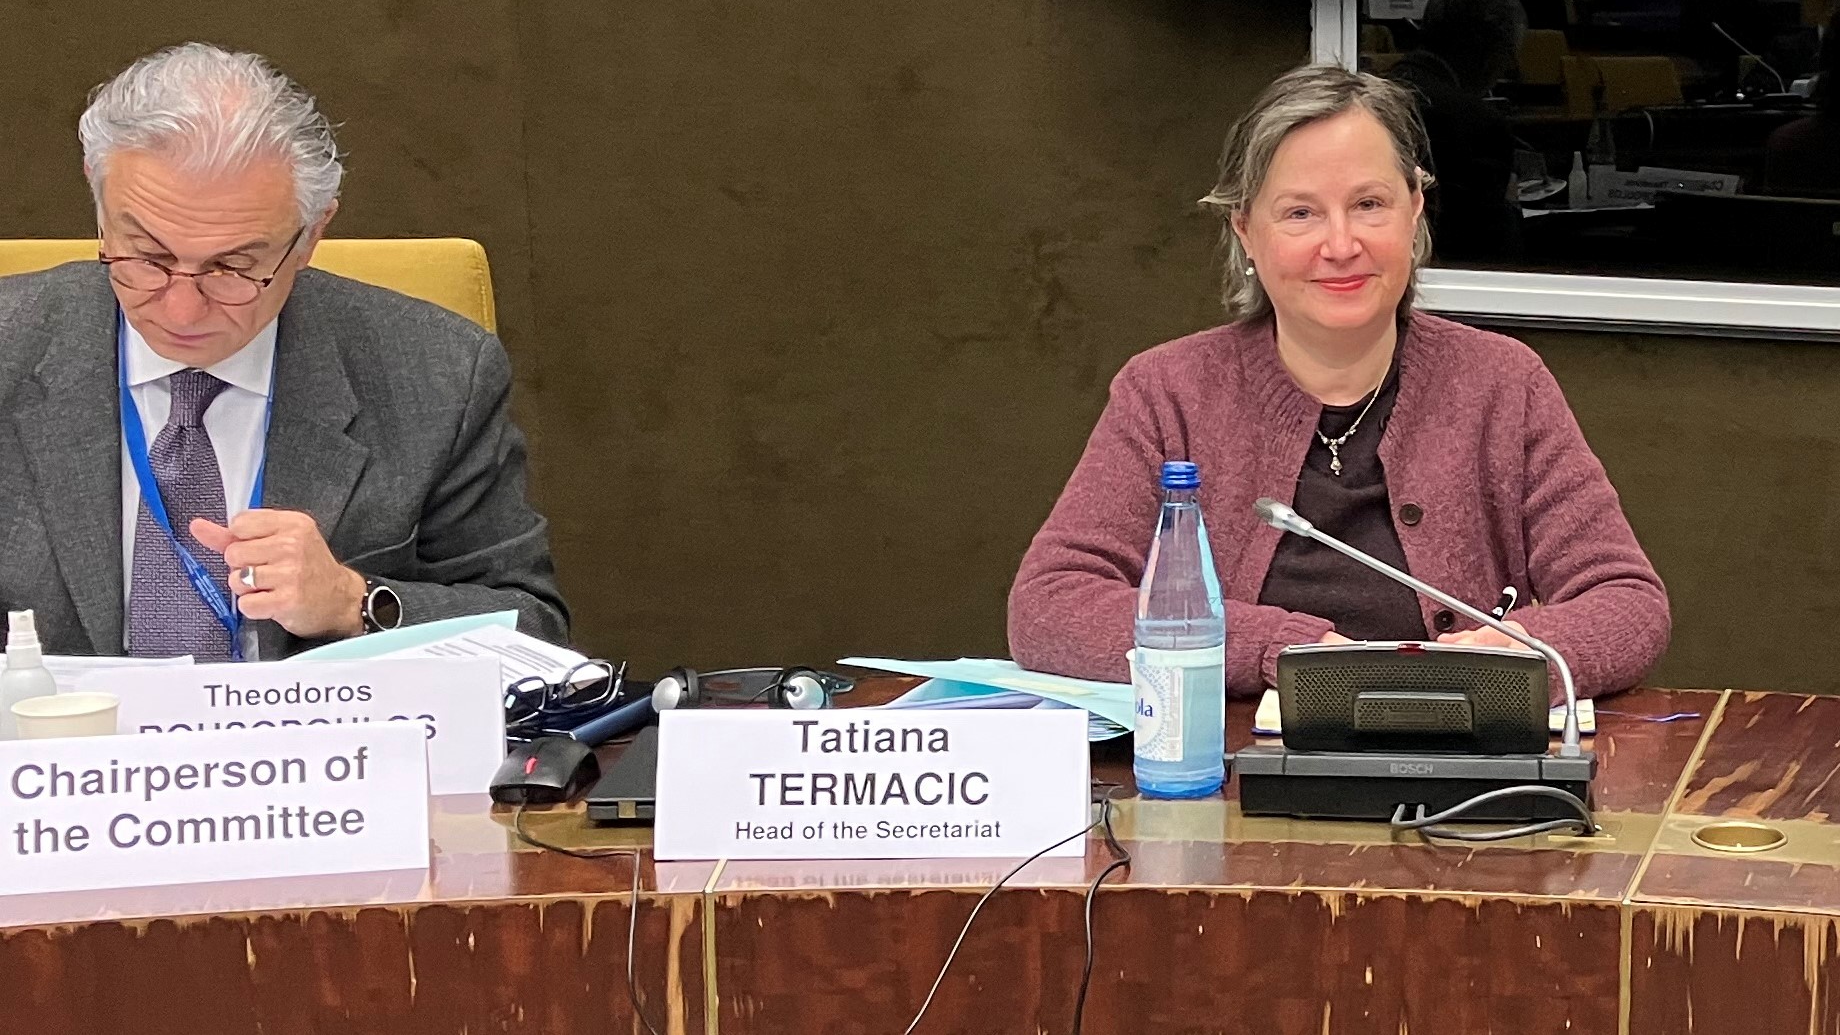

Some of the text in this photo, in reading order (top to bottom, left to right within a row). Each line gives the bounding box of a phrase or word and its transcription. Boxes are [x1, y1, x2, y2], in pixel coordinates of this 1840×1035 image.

[203, 681, 373, 708] Theodoros
[792, 719, 950, 754] Tatiana
[11, 745, 369, 802] Chairperson of
[1389, 762, 1434, 774] BOSCH
[748, 771, 989, 806] TERMACIC
[13, 805, 365, 856] the Committee
[735, 820, 1001, 840] Head of the Secretariat
